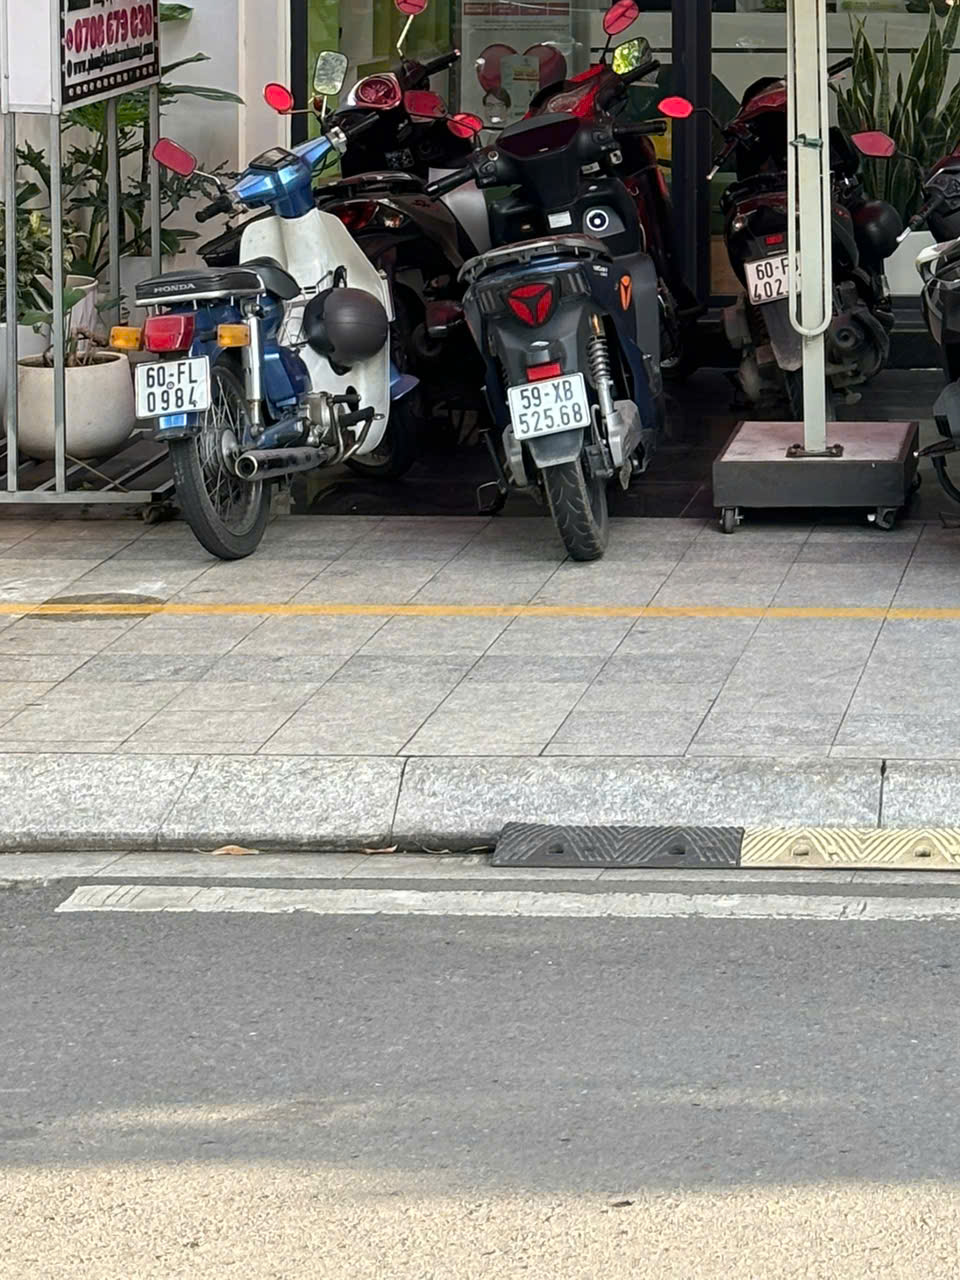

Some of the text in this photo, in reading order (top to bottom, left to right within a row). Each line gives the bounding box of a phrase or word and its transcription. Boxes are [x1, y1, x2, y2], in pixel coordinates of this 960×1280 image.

[755, 257, 799, 281] 60-F
[153, 283, 196, 294] HONDA
[146, 362, 198, 389] 60-FL
[147, 386, 198, 413] 0984
[520, 380, 574, 410] 59-XB
[519, 402, 583, 434] 525.68
